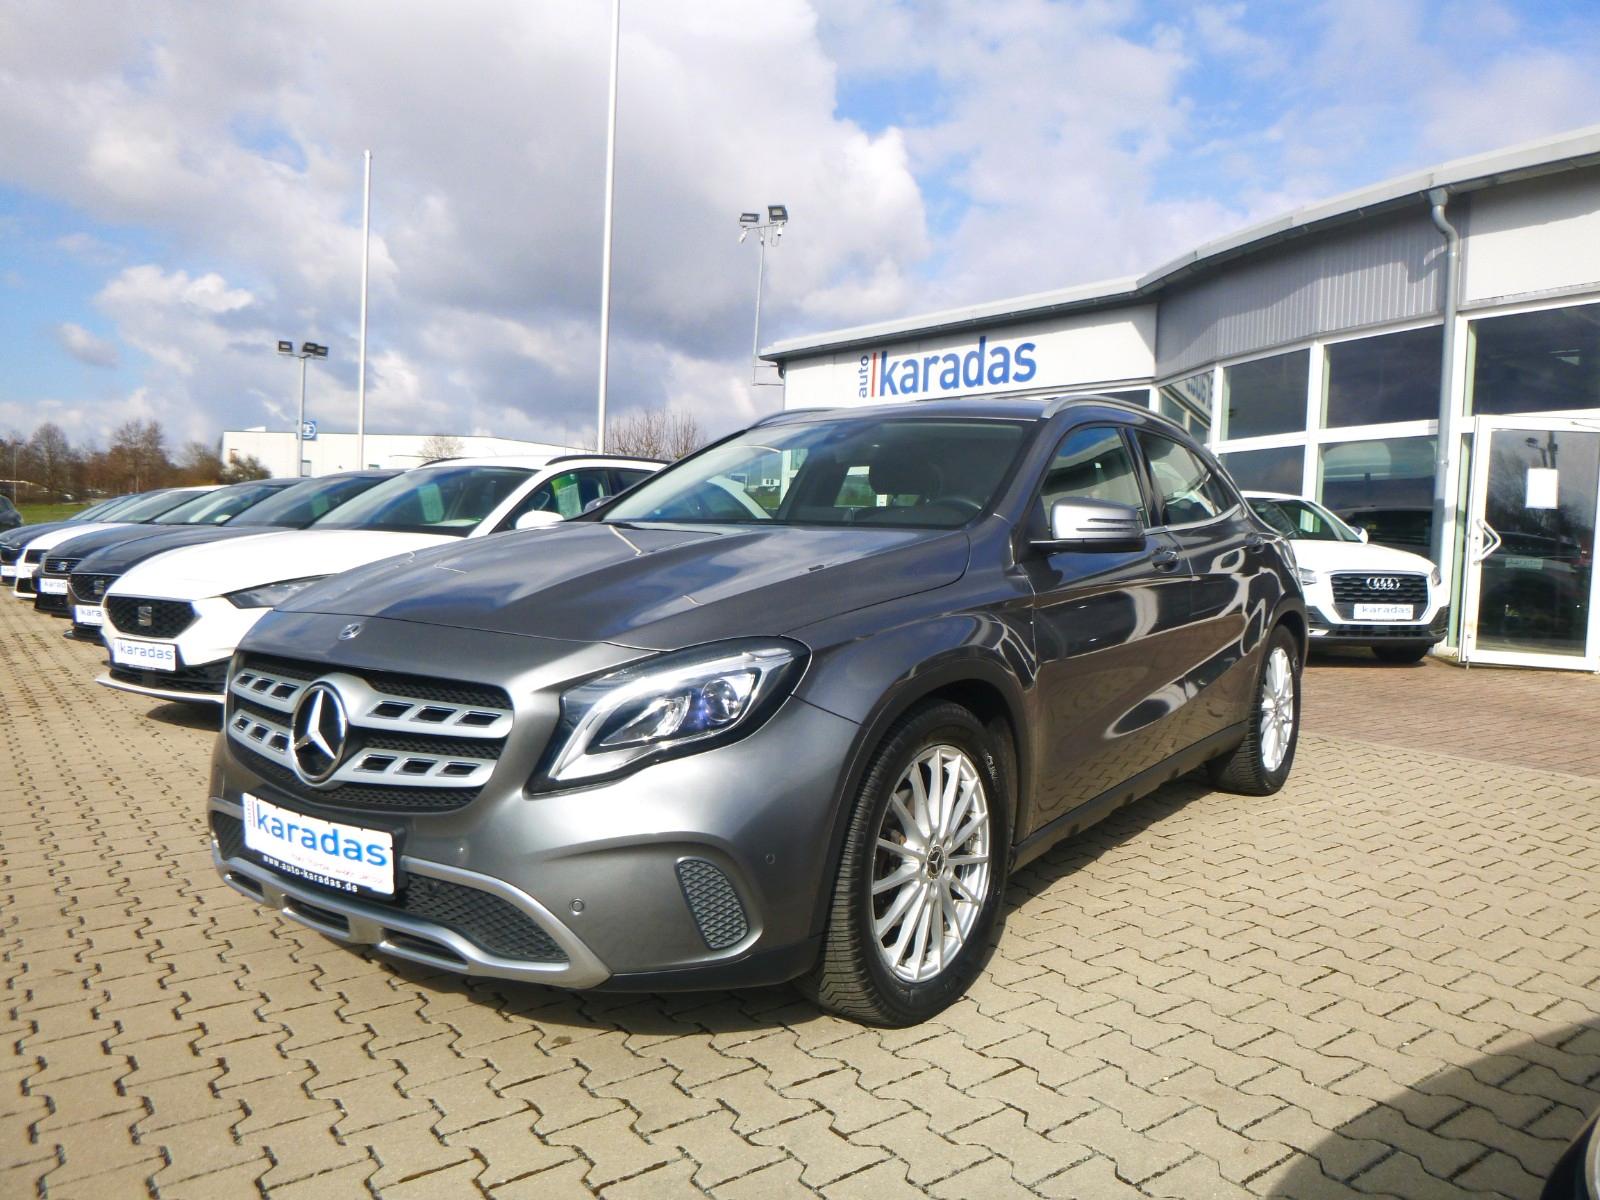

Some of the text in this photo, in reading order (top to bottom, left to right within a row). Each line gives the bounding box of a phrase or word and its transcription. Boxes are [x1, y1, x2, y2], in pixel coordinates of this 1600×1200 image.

[858, 355, 869, 398] auto
[880, 336, 1036, 396] karadas
[1362, 605, 1411, 614] karadas
[120, 641, 173, 660] karadas
[256, 804, 388, 866] karadas
[263, 855, 358, 893] www.auto-karadas.de
